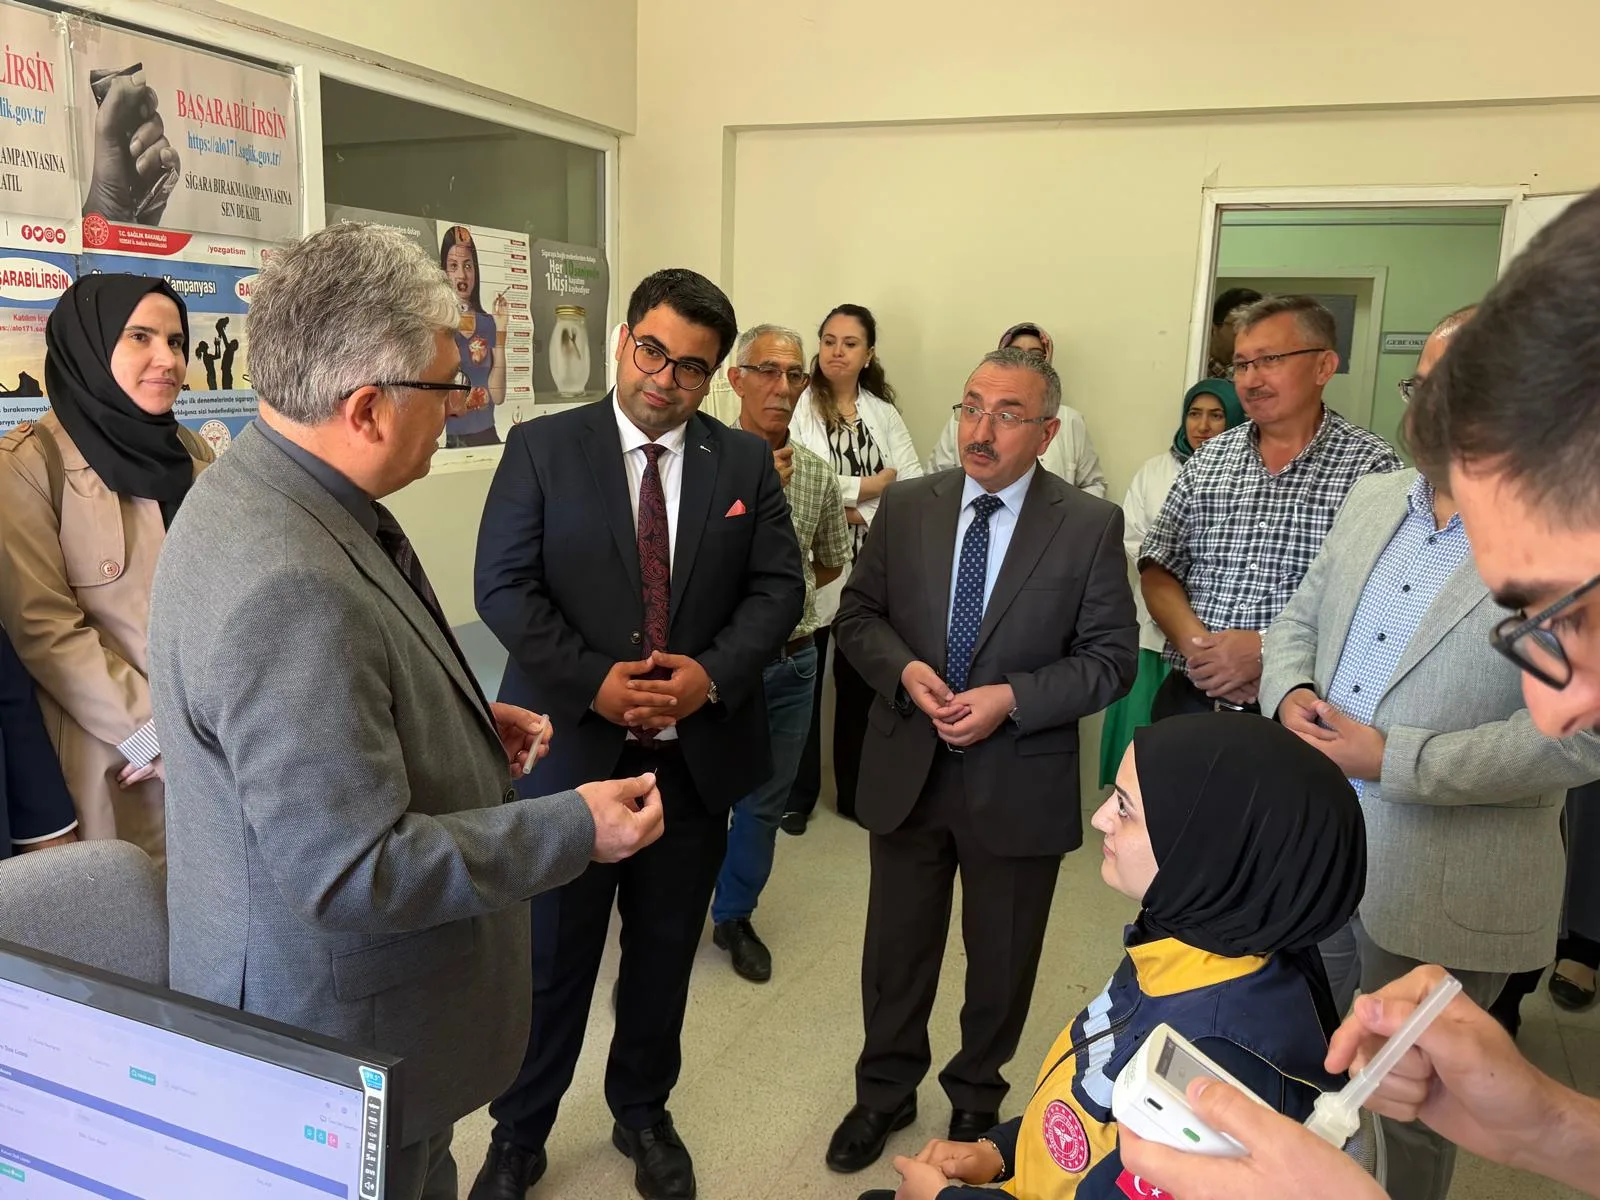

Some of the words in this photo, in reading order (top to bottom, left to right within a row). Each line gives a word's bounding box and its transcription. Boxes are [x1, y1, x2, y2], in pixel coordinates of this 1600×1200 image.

[176, 89, 286, 140] BAŞARABİLİRSİN
[0, 147, 65, 173] AMPANYASINA
[0, 173, 22, 192] ATIL
[185, 171, 213, 193] SİGARA
[213, 178, 244, 200] BIRAKMA
[244, 184, 292, 206] KAMPANYASINA
[221, 201, 235, 217] SEN
[236, 203, 245, 219] DE
[245, 206, 262, 222] KATIL
[549, 259, 563, 274] Her
[163, 275, 216, 297] Kampanyası
